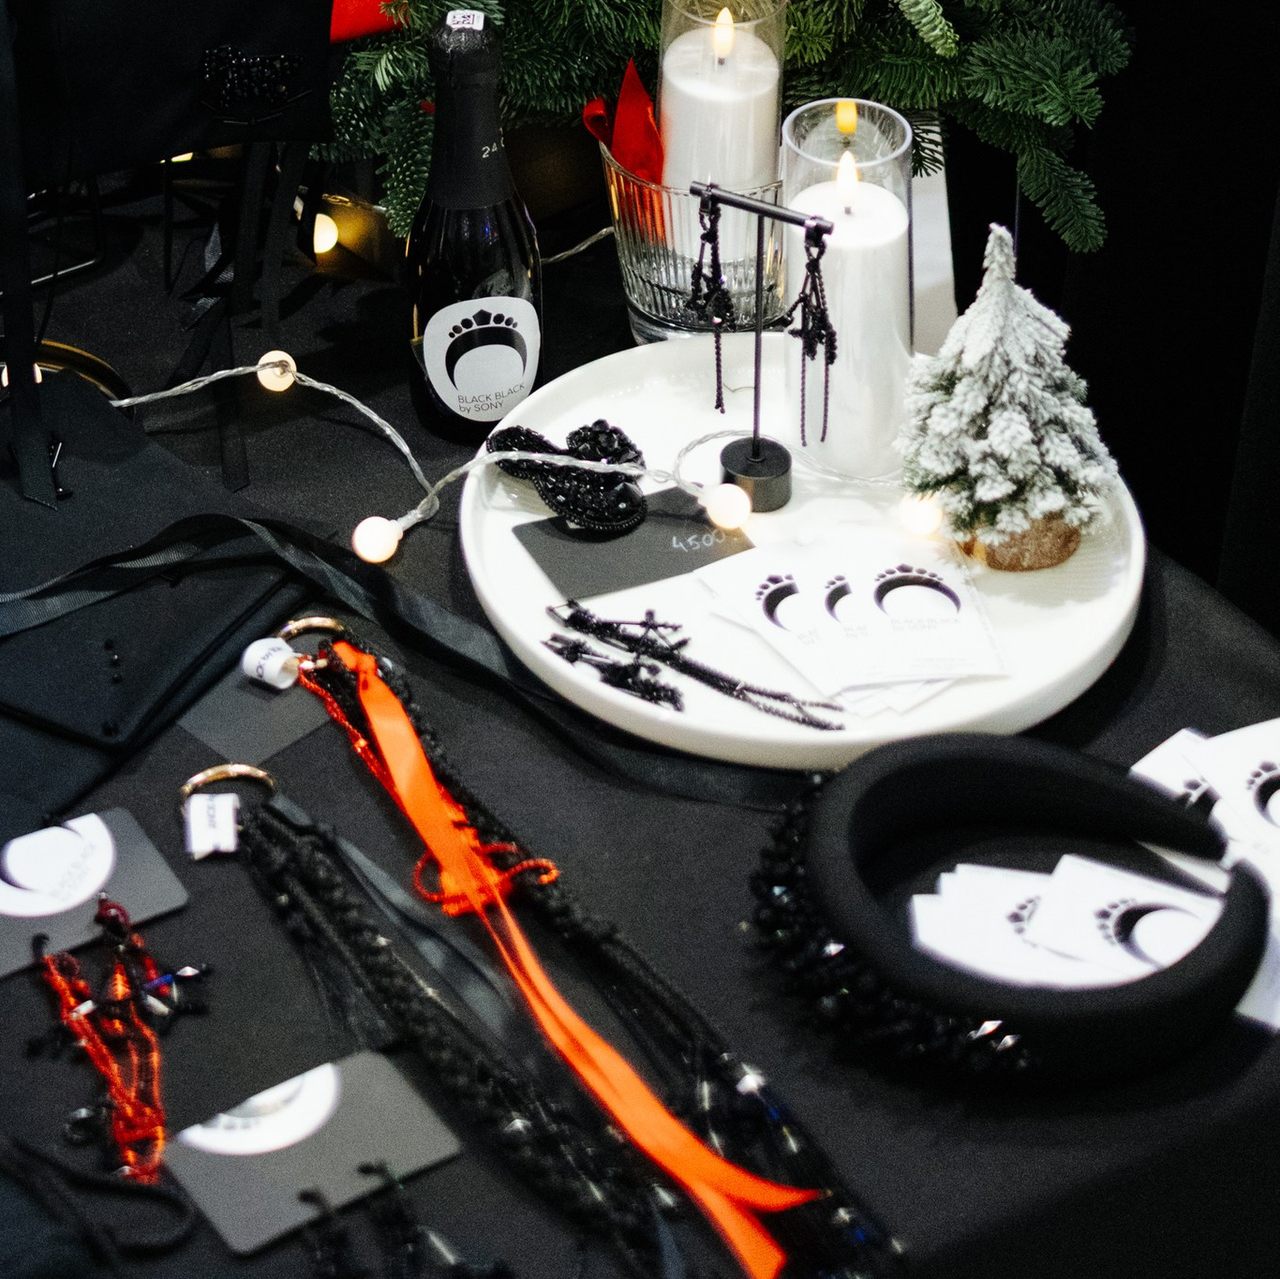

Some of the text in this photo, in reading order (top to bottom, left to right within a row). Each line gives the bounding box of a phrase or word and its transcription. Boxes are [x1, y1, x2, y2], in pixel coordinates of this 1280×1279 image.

[458, 383, 525, 404] BLACK BLACK
[458, 400, 504, 414] by SONY
